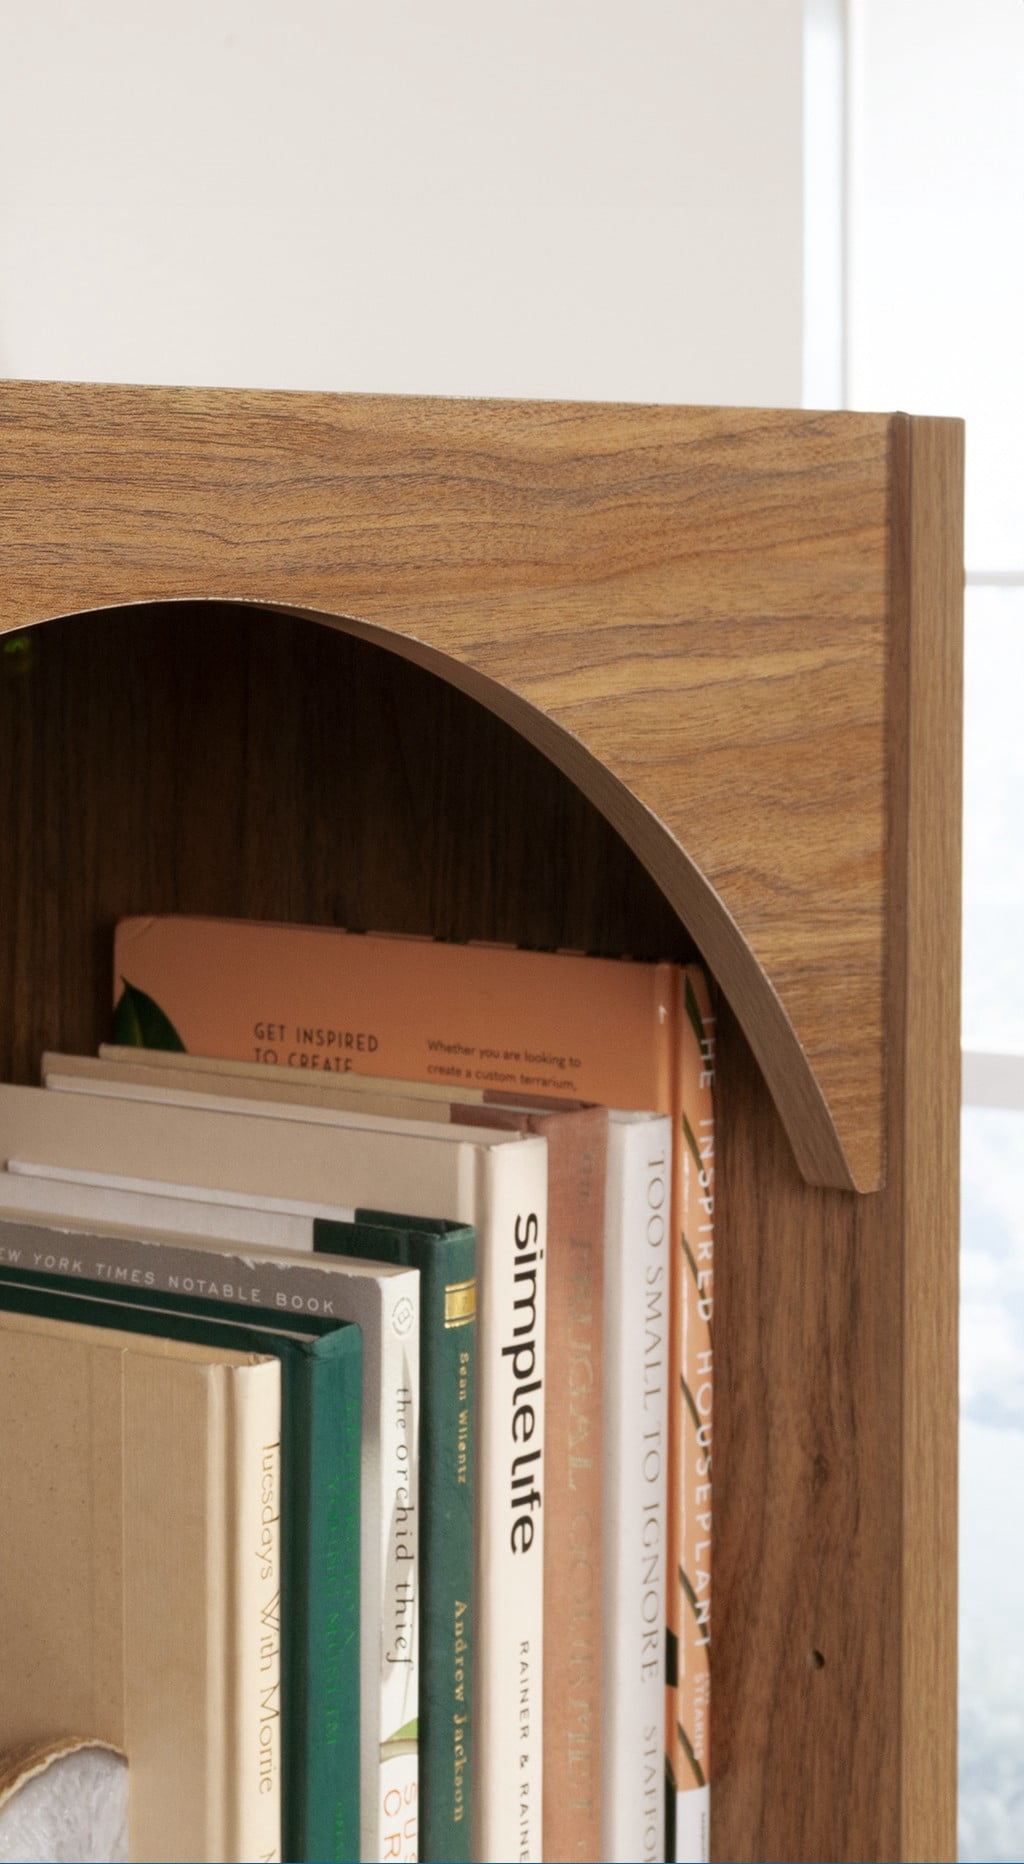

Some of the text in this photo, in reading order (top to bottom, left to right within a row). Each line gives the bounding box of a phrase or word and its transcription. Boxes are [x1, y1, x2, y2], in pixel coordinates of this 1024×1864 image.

[254, 1021, 379, 1053] GET INSPIRED
[254, 1048, 279, 1065] TO
[427, 1039, 581, 1070] Whether you are looking to
[427, 1064, 462, 1078] create
[476, 1070, 516, 1083] custom
[33, 1253, 83, 1274] YORK
[95, 1263, 156, 1286] TIMES
[167, 1275, 262, 1304] NOTABLE
[275, 1293, 335, 1315] BOOK
[694, 1016, 717, 1647] THE INSPIRED HOUSEPLANT
[456, 1351, 471, 1485] Sean Wilentz
[641, 1150, 666, 1683] TOO SMALL TO IGNORE
[385, 1387, 415, 1671] the orchid thief
[258, 1680, 281, 1796] Morrie
[453, 1599, 469, 1823] Andrew Jackson
[519, 1640, 531, 1740] RAINER
[519, 1753, 530, 1769] &
[642, 1725, 658, 1862] STAFFO
